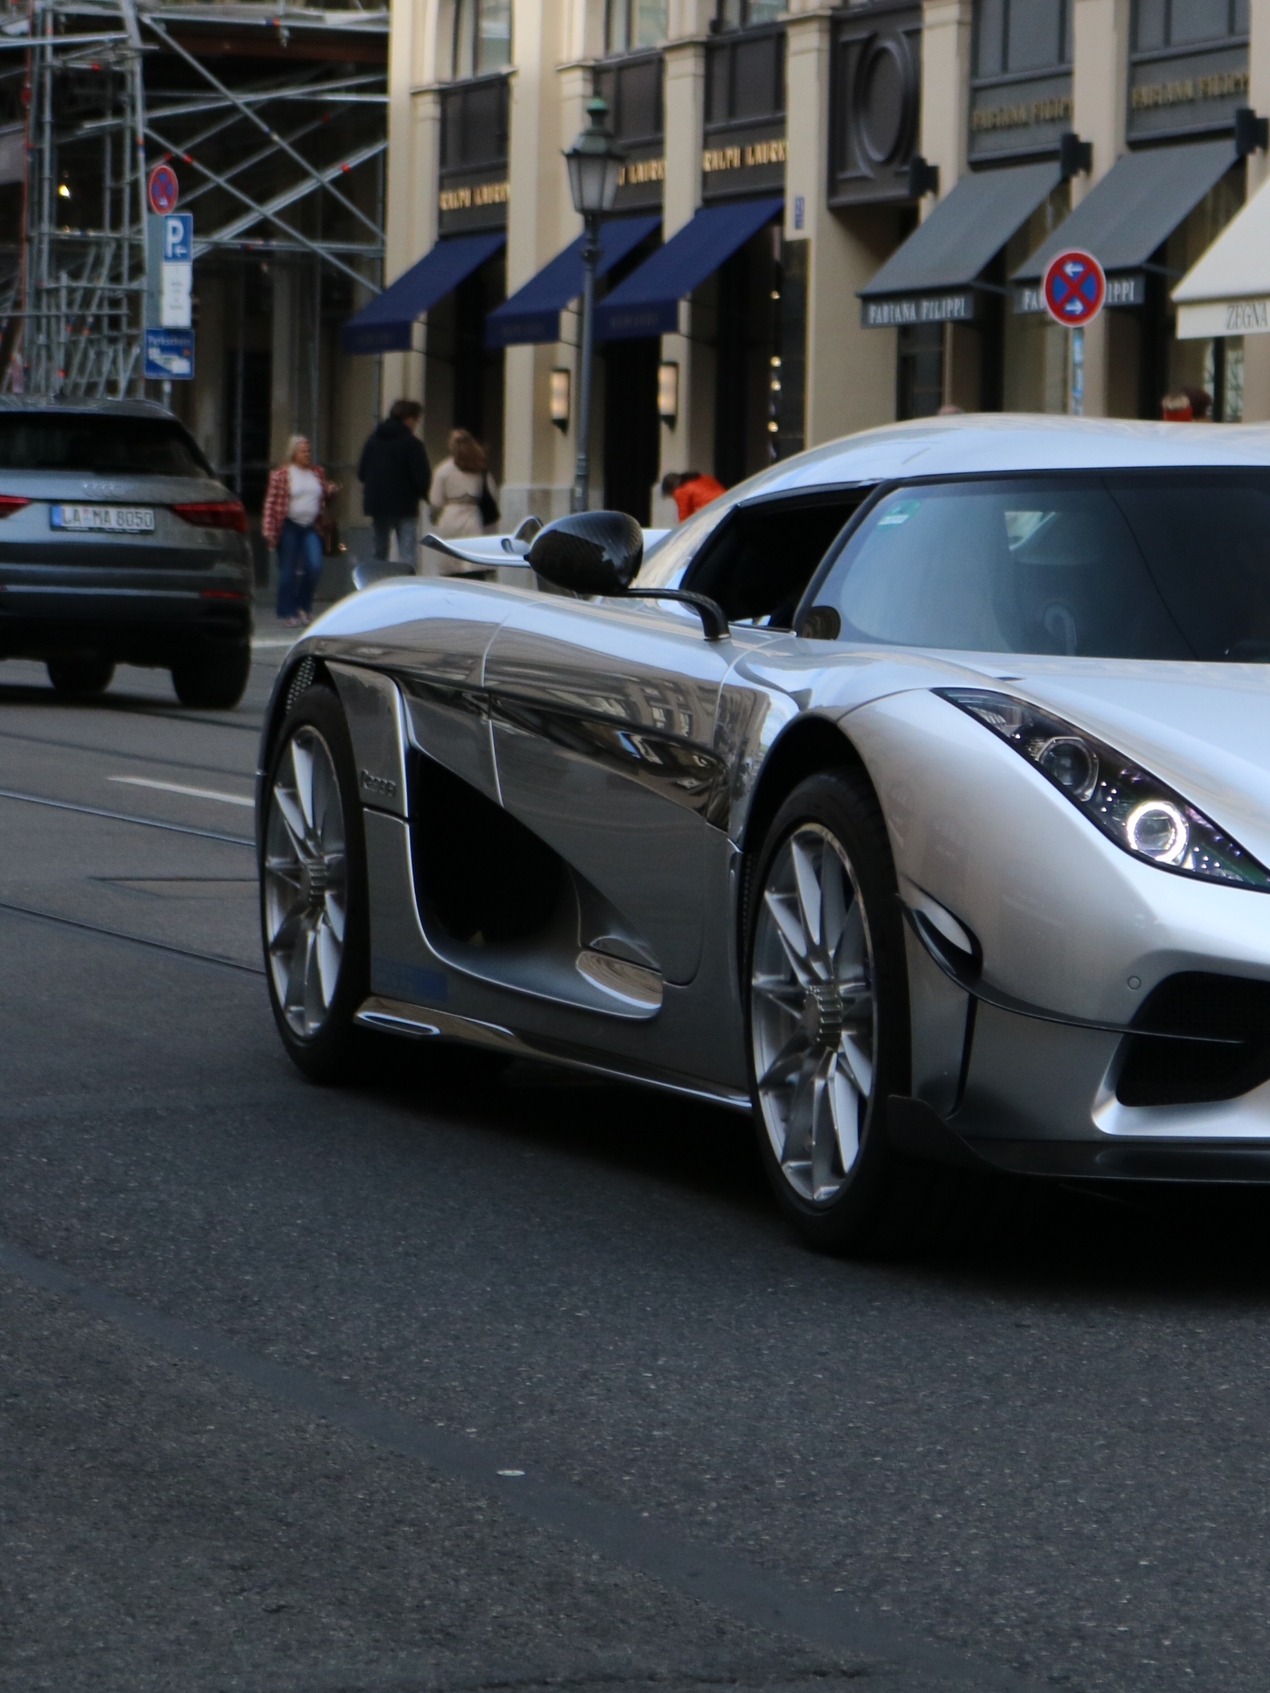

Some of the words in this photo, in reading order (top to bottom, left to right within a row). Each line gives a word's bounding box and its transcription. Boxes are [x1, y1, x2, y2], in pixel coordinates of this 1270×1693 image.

[703, 146, 741, 172] RALPH
[745, 140, 788, 166] LAURE
[166, 218, 184, 258] P
[868, 301, 916, 324] FABIANA
[921, 297, 965, 320] FILIPPI
[1226, 302, 1268, 330] ZEGNA
[63, 508, 81, 525] LA
[93, 509, 111, 526] MA
[117, 510, 153, 528] 8050
